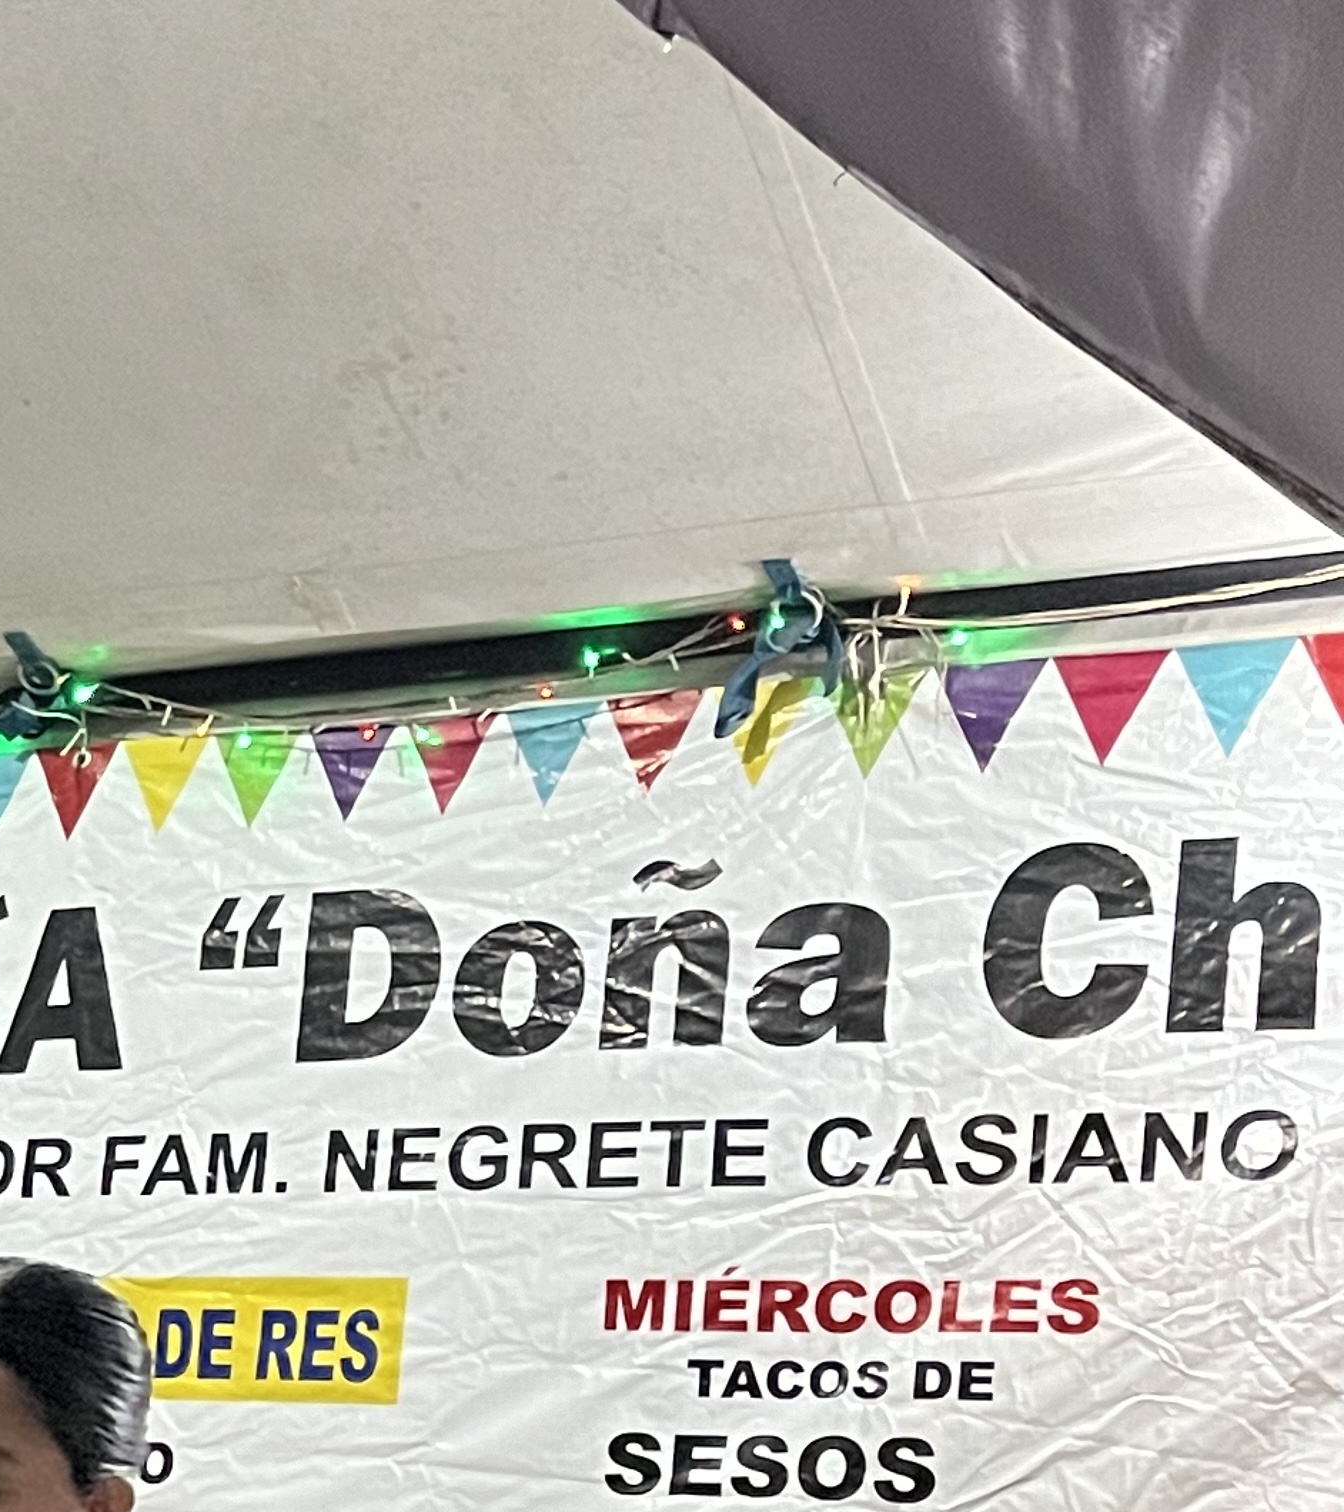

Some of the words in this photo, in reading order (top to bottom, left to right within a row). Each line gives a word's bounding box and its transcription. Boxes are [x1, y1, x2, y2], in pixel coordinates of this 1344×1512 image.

[100, 1131, 288, 1196] FAM.
[323, 1117, 770, 1194] NEGRETE
[806, 1108, 1299, 1188] CASIANO
[604, 1267, 1100, 1335] MIÉRCOLES
[154, 1309, 236, 1380] DE
[255, 1309, 380, 1383] RES
[687, 1359, 888, 1399] TACOS
[912, 1360, 995, 1401] DE
[604, 1432, 937, 1503] SESOS
